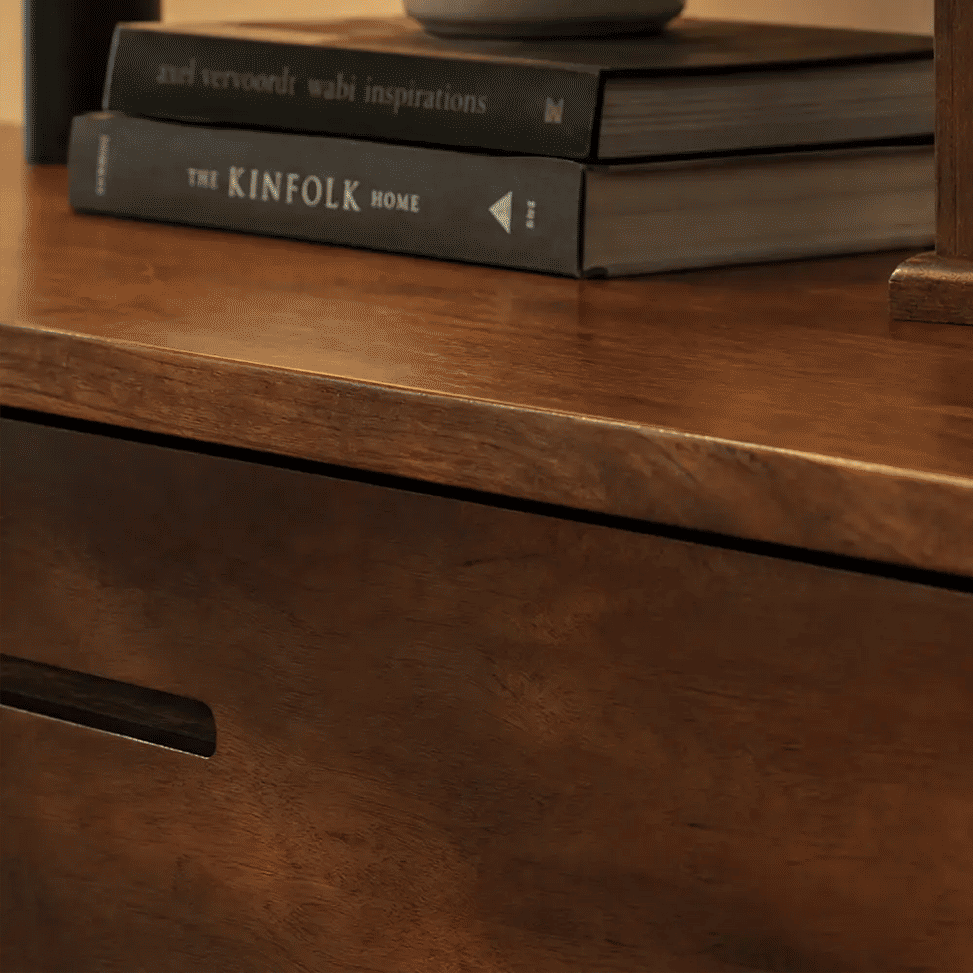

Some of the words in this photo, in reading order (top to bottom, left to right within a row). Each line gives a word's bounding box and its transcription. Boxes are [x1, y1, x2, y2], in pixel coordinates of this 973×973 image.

[307, 72, 356, 102] wabi
[364, 76, 488, 115] inspirations
[228, 165, 361, 212] KINFOLK
[370, 189, 420, 213] HOME
